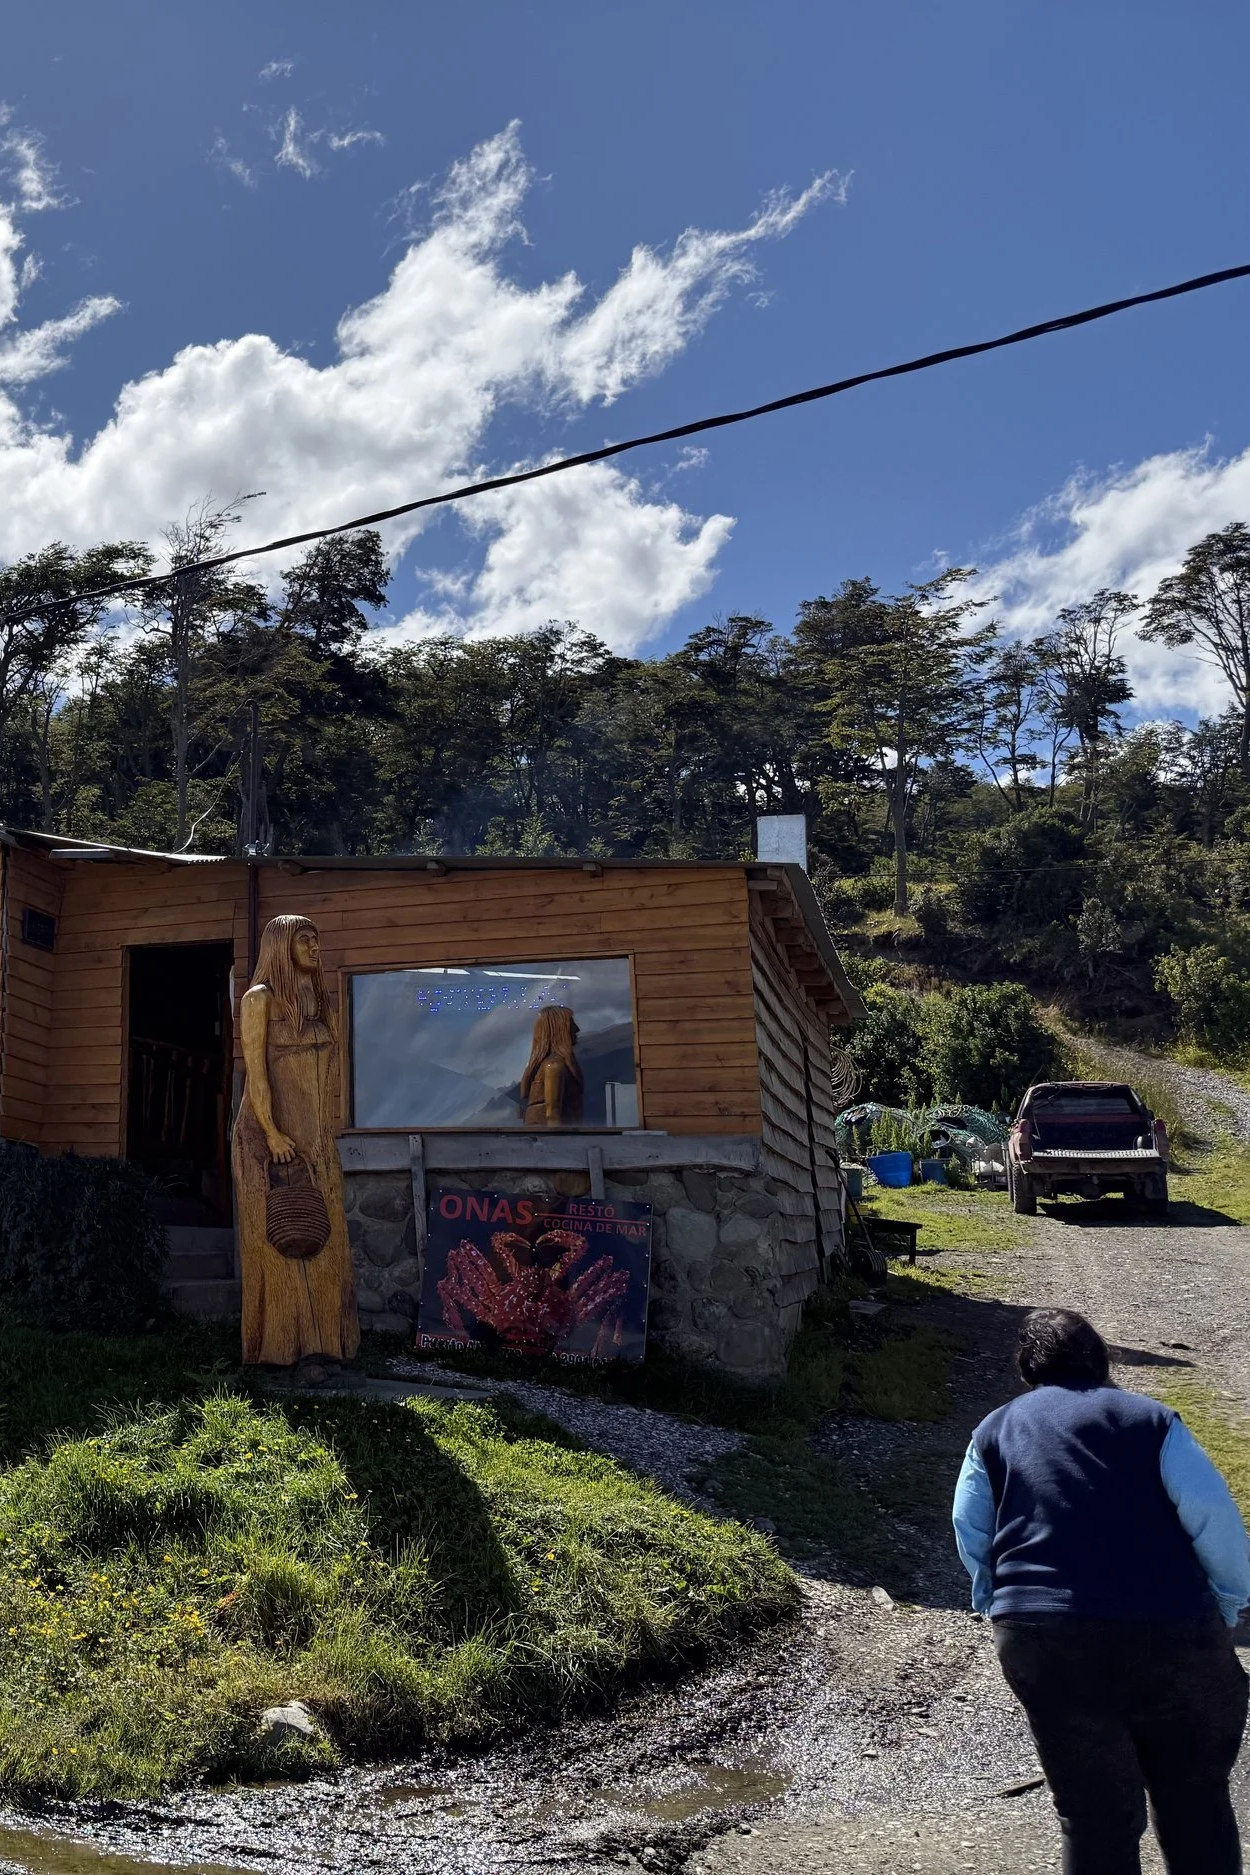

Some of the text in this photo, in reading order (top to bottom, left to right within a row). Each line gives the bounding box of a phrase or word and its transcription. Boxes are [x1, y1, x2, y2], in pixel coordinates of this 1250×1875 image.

[439, 1194, 534, 1226] ONAS
[569, 1203, 615, 1218] RESTÓ
[543, 1218, 647, 1237] COCINA DE MAR
